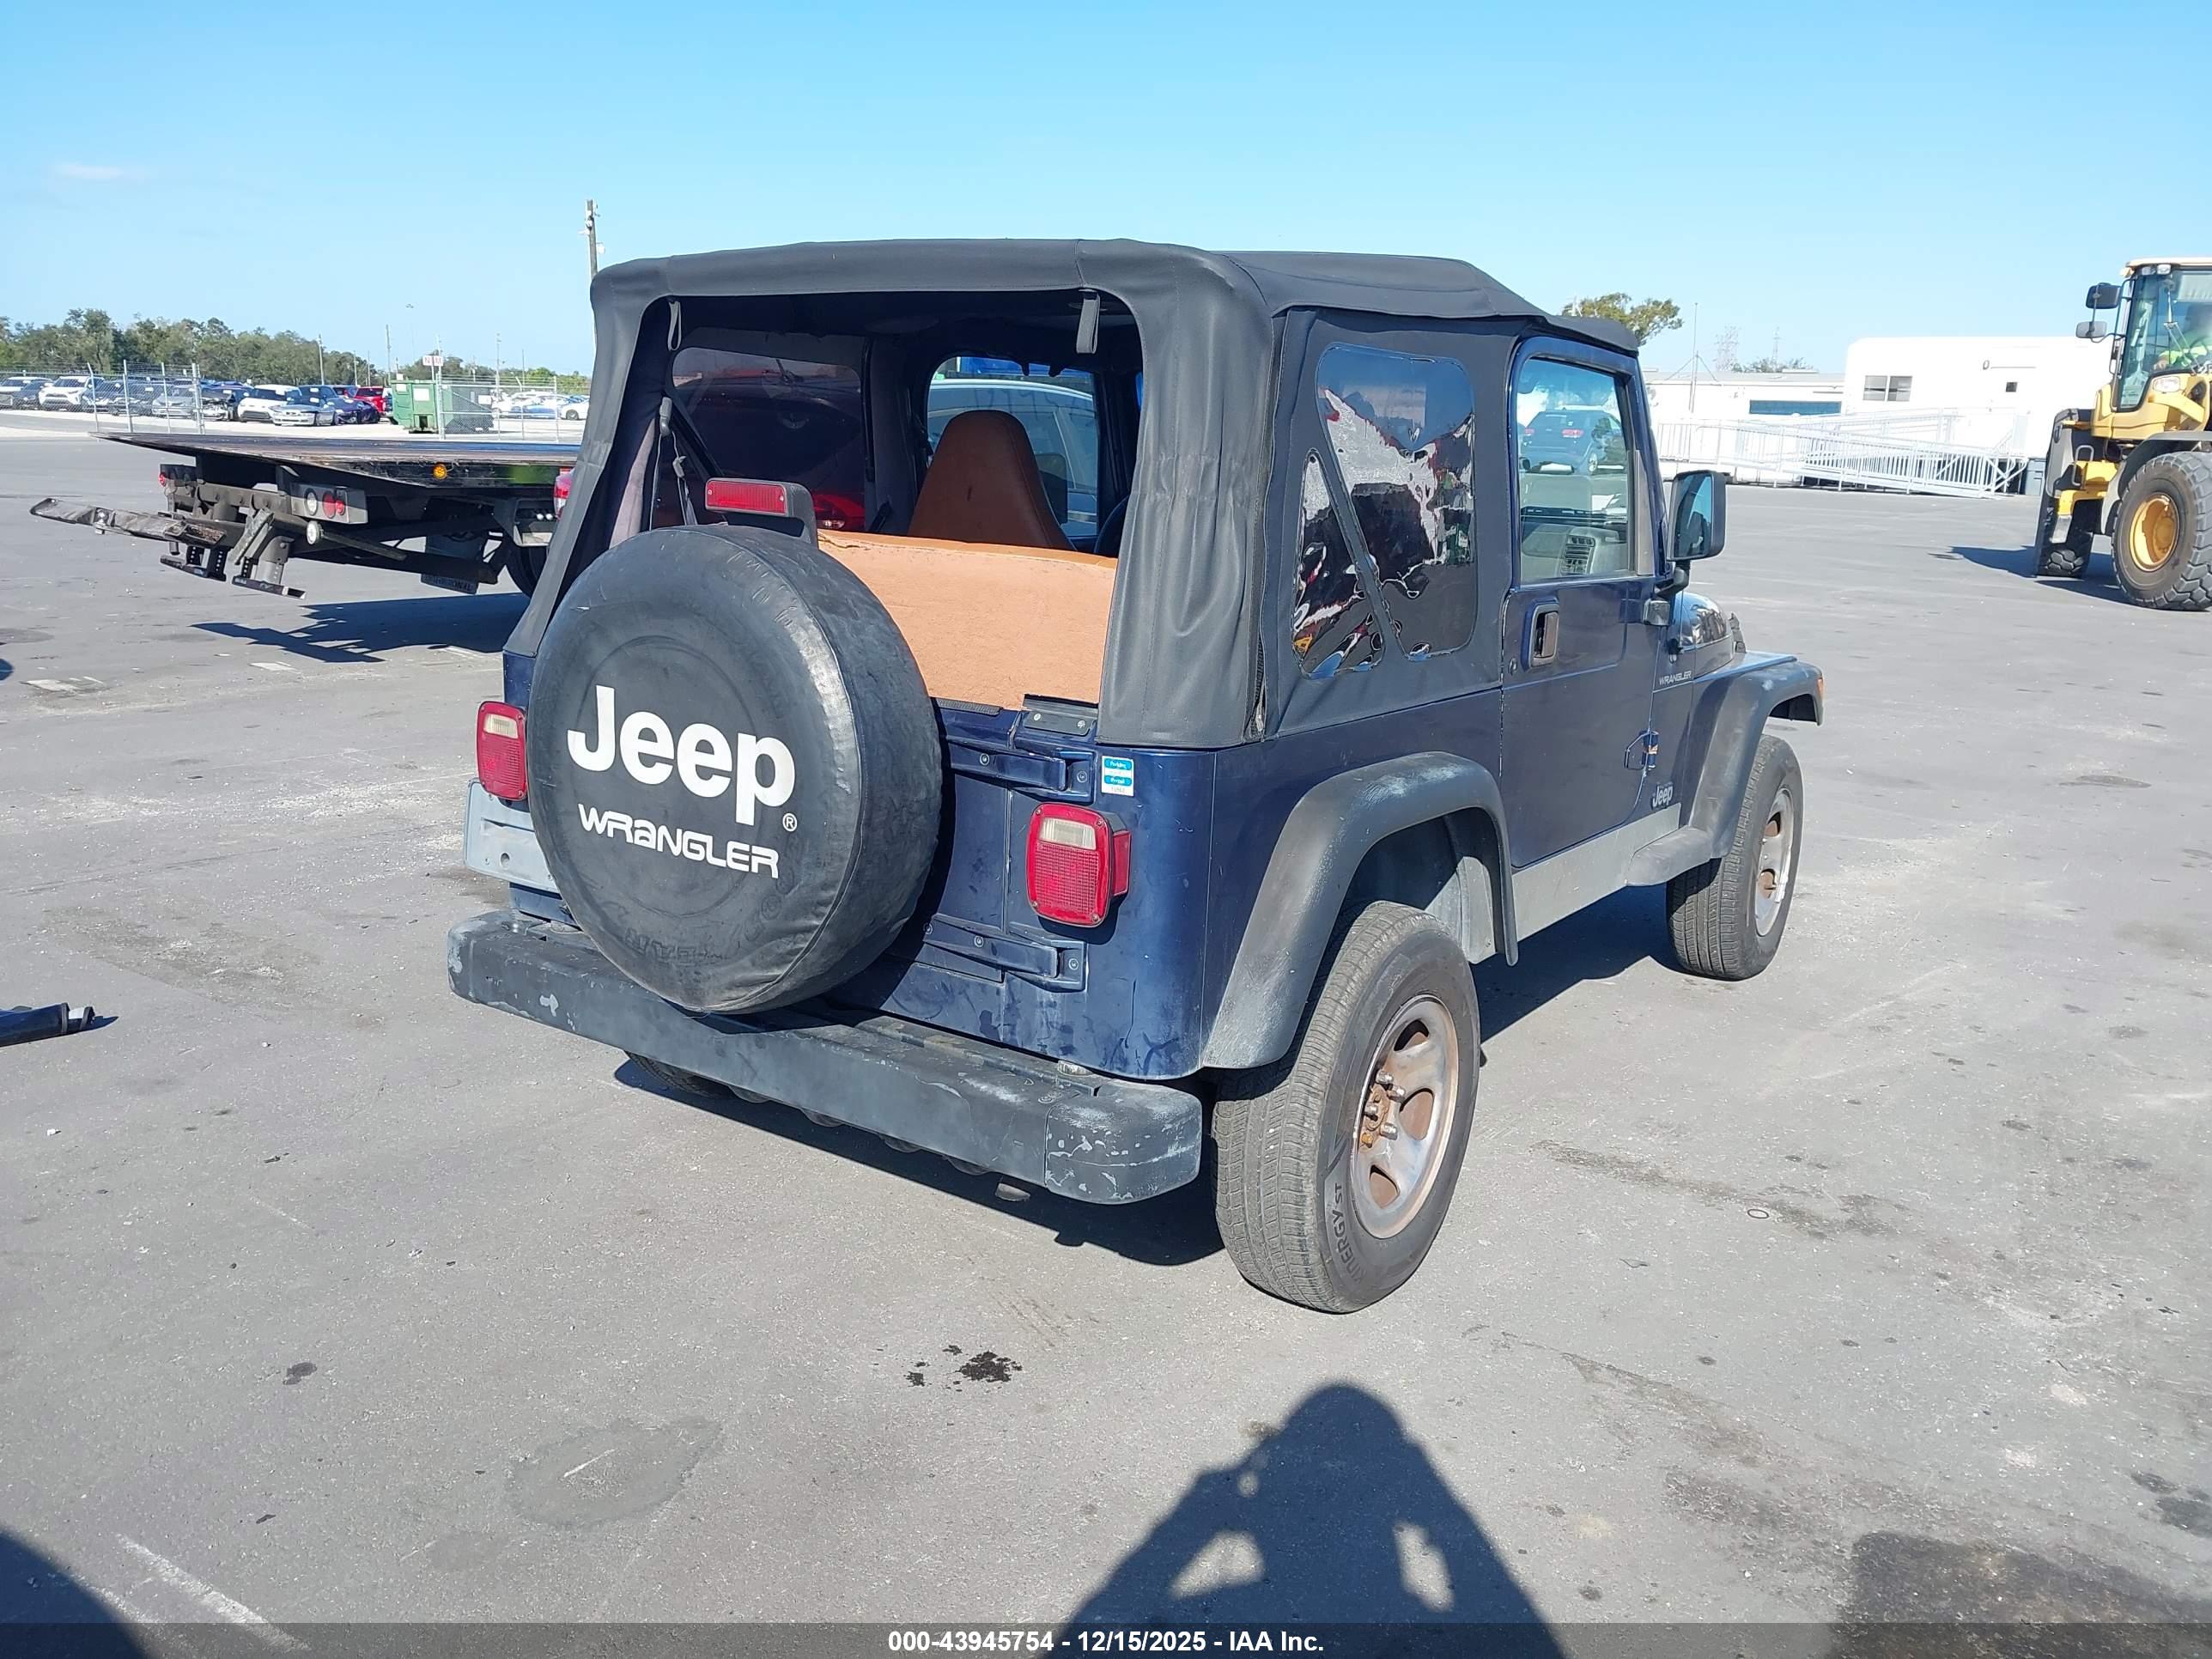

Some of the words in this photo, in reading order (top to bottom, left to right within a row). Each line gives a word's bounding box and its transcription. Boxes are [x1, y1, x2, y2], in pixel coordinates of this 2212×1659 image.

[1659, 670, 1692, 685] WRANGLER
[568, 684, 796, 826] Jeep
[1652, 785, 1674, 807] Jeep
